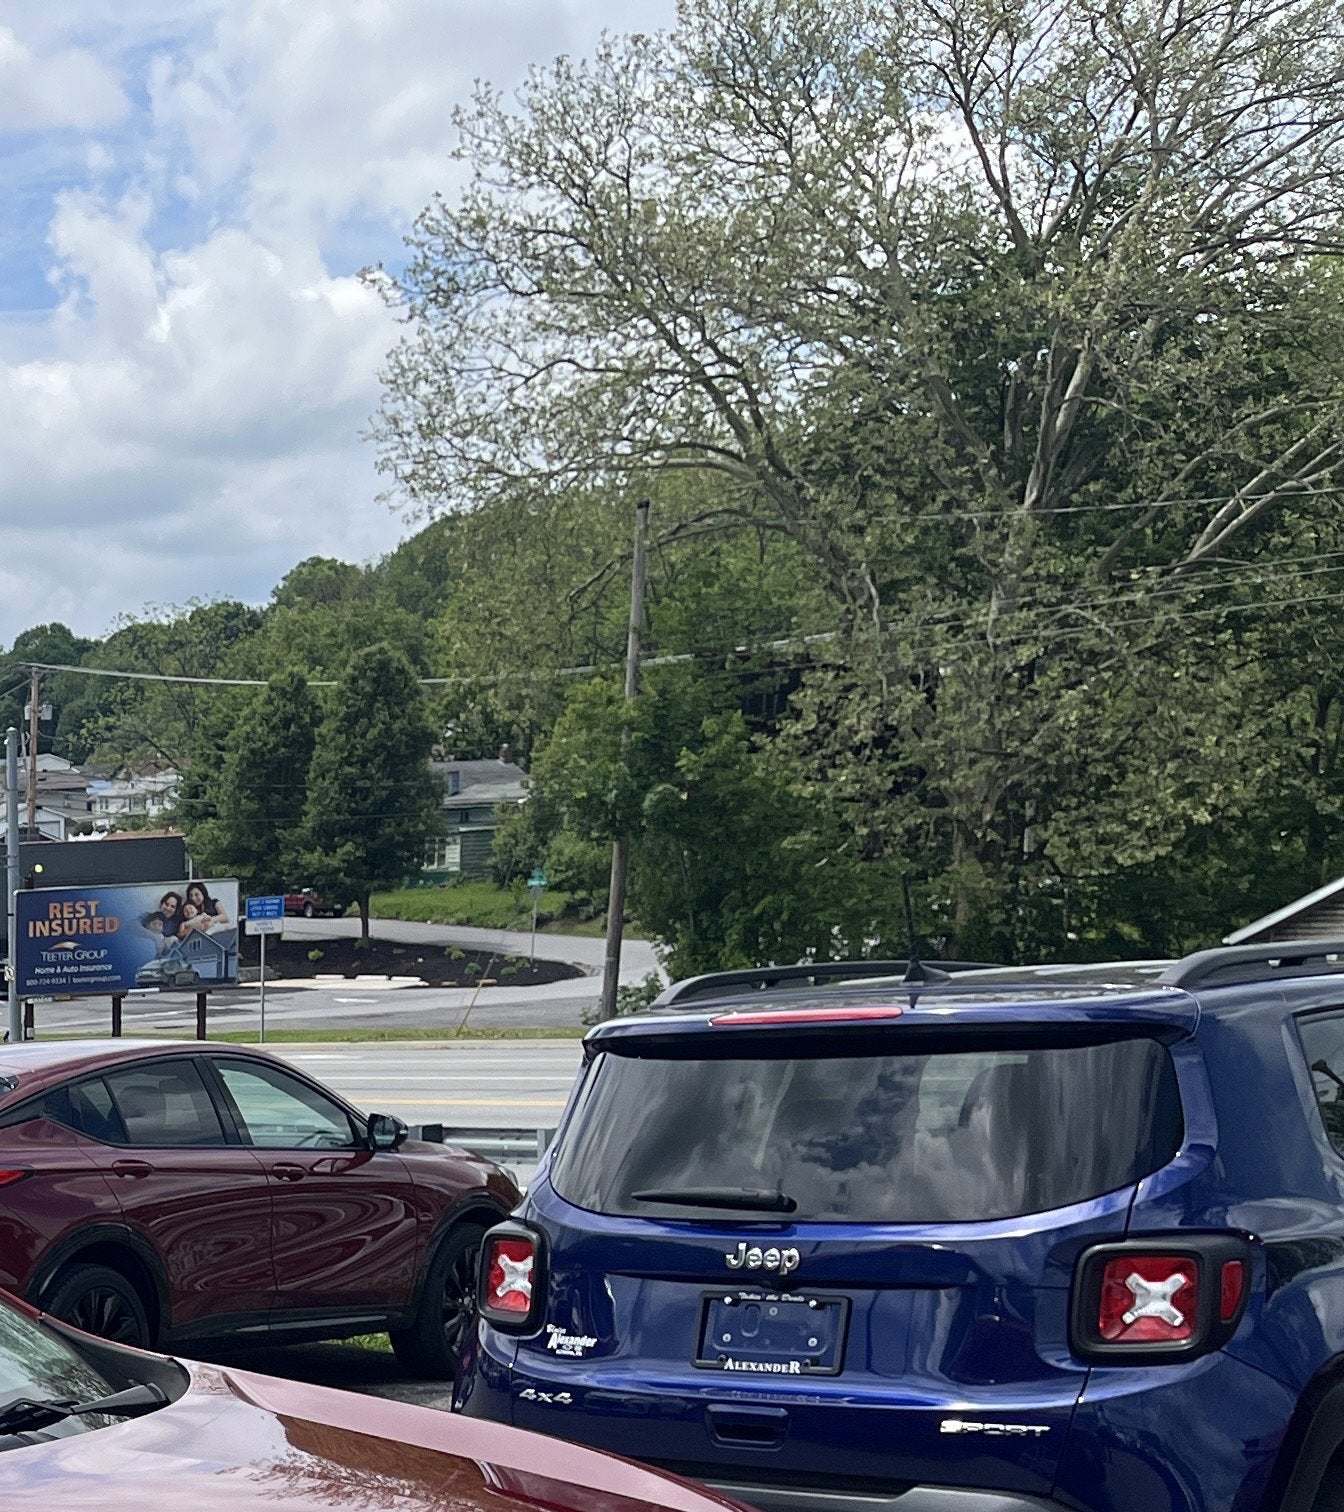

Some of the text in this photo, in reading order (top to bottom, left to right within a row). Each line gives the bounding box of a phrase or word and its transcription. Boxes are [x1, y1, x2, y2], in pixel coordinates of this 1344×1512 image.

[49, 901, 100, 919] REST
[28, 916, 120, 938] INSURED
[41, 949, 108, 961] TEETER GROUP
[80, 964, 112, 972] Insurance
[725, 1242, 800, 1275] Jeep
[547, 1332, 597, 1349] Alexander
[723, 1357, 801, 1374] ALEXANDER
[519, 1388, 573, 1404] 4x4
[940, 1420, 1050, 1436] SPORT
